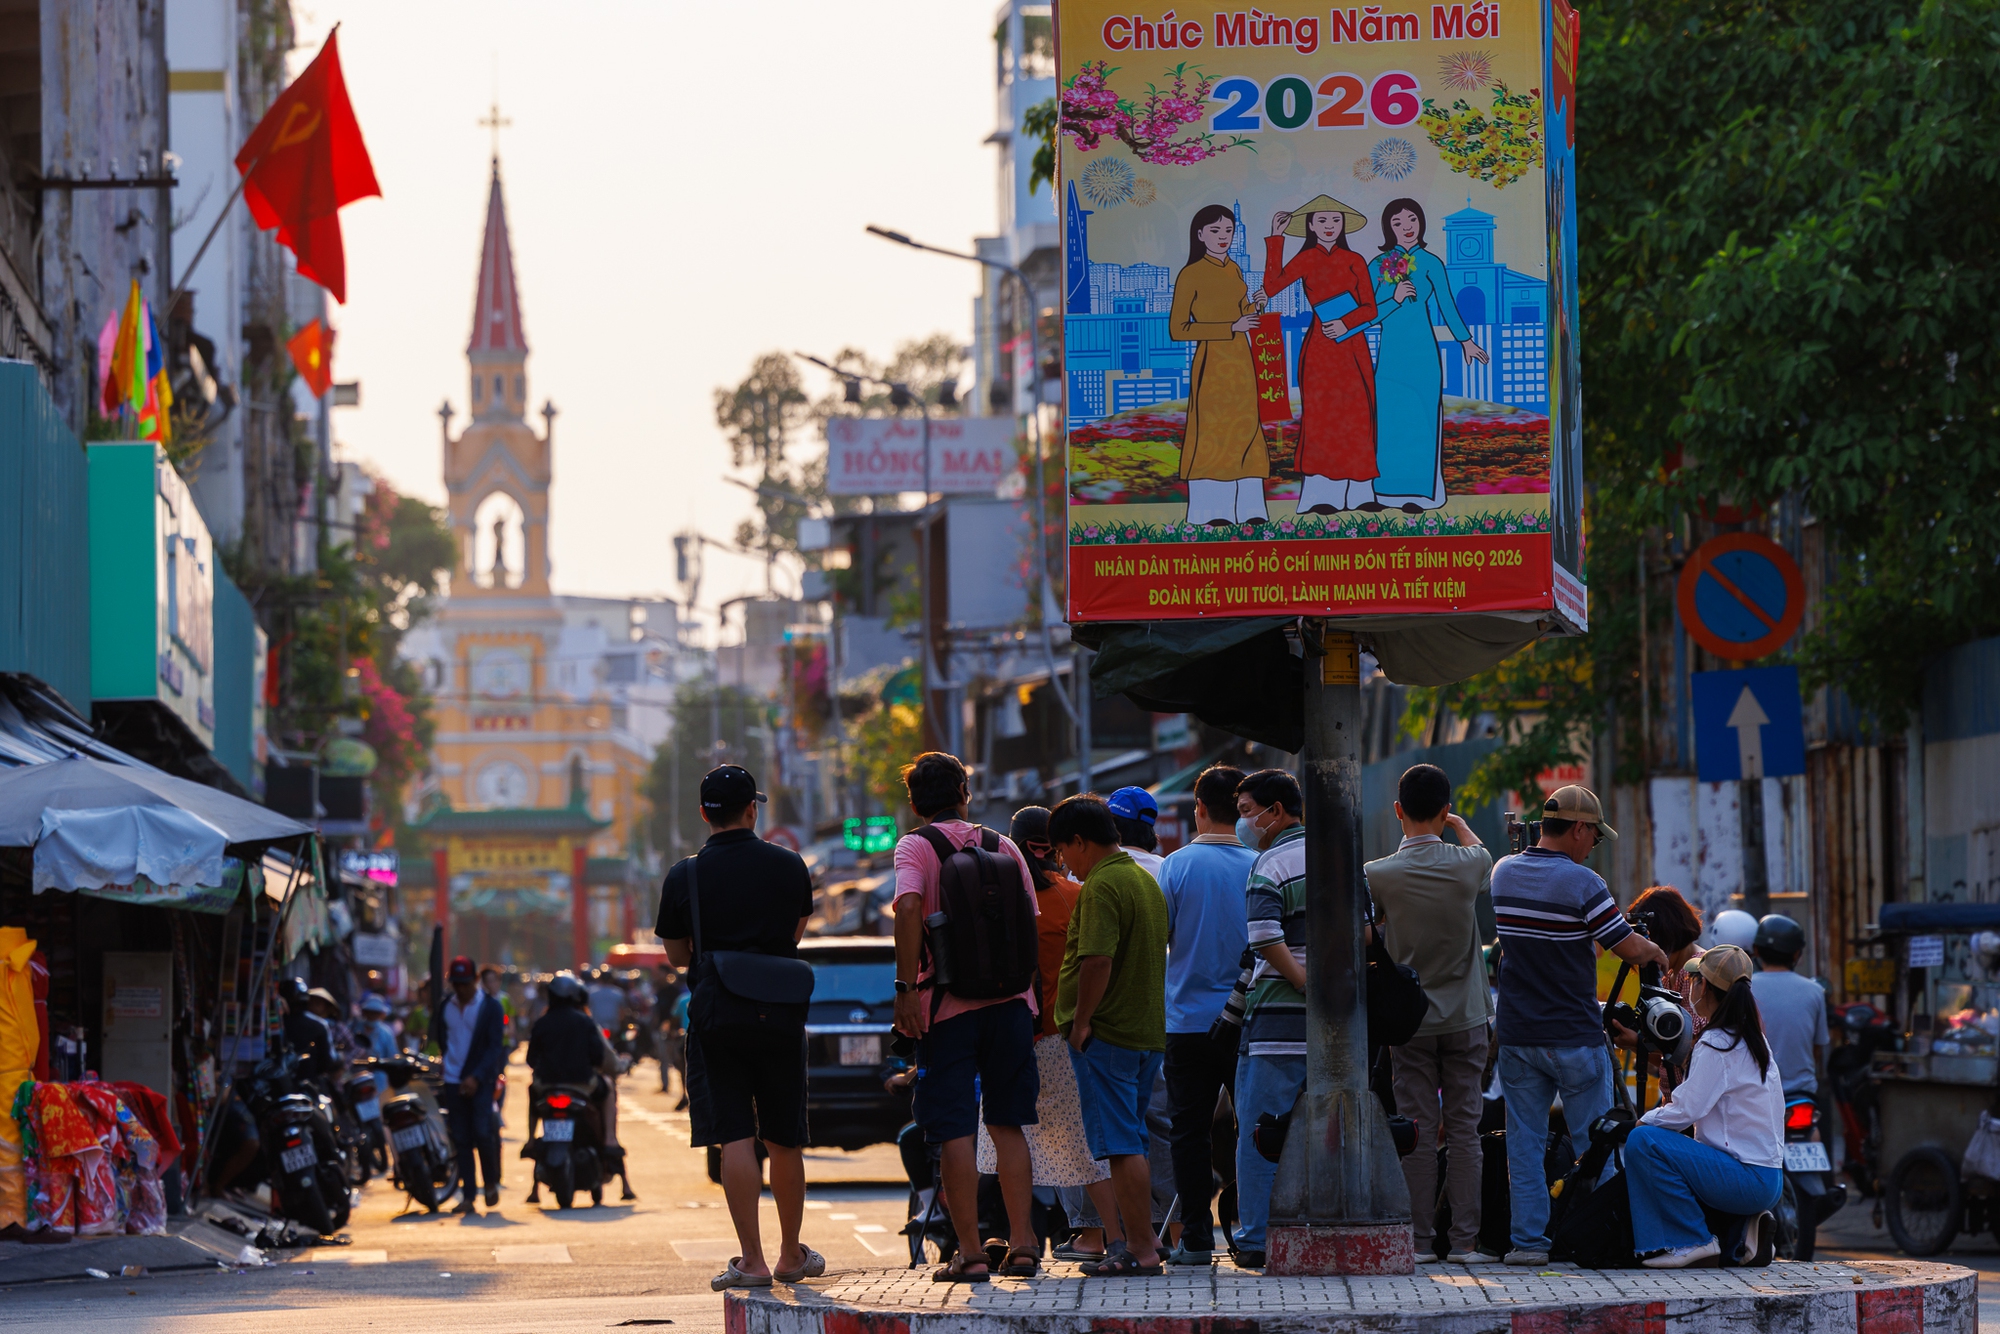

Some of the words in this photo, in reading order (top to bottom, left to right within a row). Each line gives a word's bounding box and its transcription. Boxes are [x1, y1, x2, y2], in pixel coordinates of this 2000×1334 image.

[1102, 9, 1203, 51] Chúc
[1214, 8, 1319, 55] Mừng
[1332, 6, 1419, 44] Năm
[1432, 1, 1500, 40] Mới
[1210, 71, 1422, 132] 2026
[1094, 555, 1135, 577] NHÂN
[1139, 554, 1169, 575] DÂN
[1173, 553, 1220, 575] THÀNH
[1225, 550, 1255, 574] PHỐ
[1258, 548, 1280, 573] HỒ
[1284, 550, 1310, 572] CHÍ
[1314, 554, 1350, 571] MINH
[1354, 548, 1386, 570] ĐÓN
[1390, 545, 1411, 569] TẾT
[1415, 547, 1448, 569] BÍNH
[1452, 550, 1485, 572] NGỌ
[1489, 549, 1523, 567] 2026
[1149, 583, 1191, 606] ĐOÀN
[1195, 581, 1221, 607] KẾT,
[1225, 586, 1248, 604] VUI
[1252, 583, 1288, 605] TƯƠI,
[1292, 581, 1329, 603] LÀNH
[1333, 583, 1376, 606] MẠNH
[1380, 578, 1400, 600] VÀ
[1403, 575, 1429, 599] TIẾT
[1433, 577, 1466, 603] KIỆM
